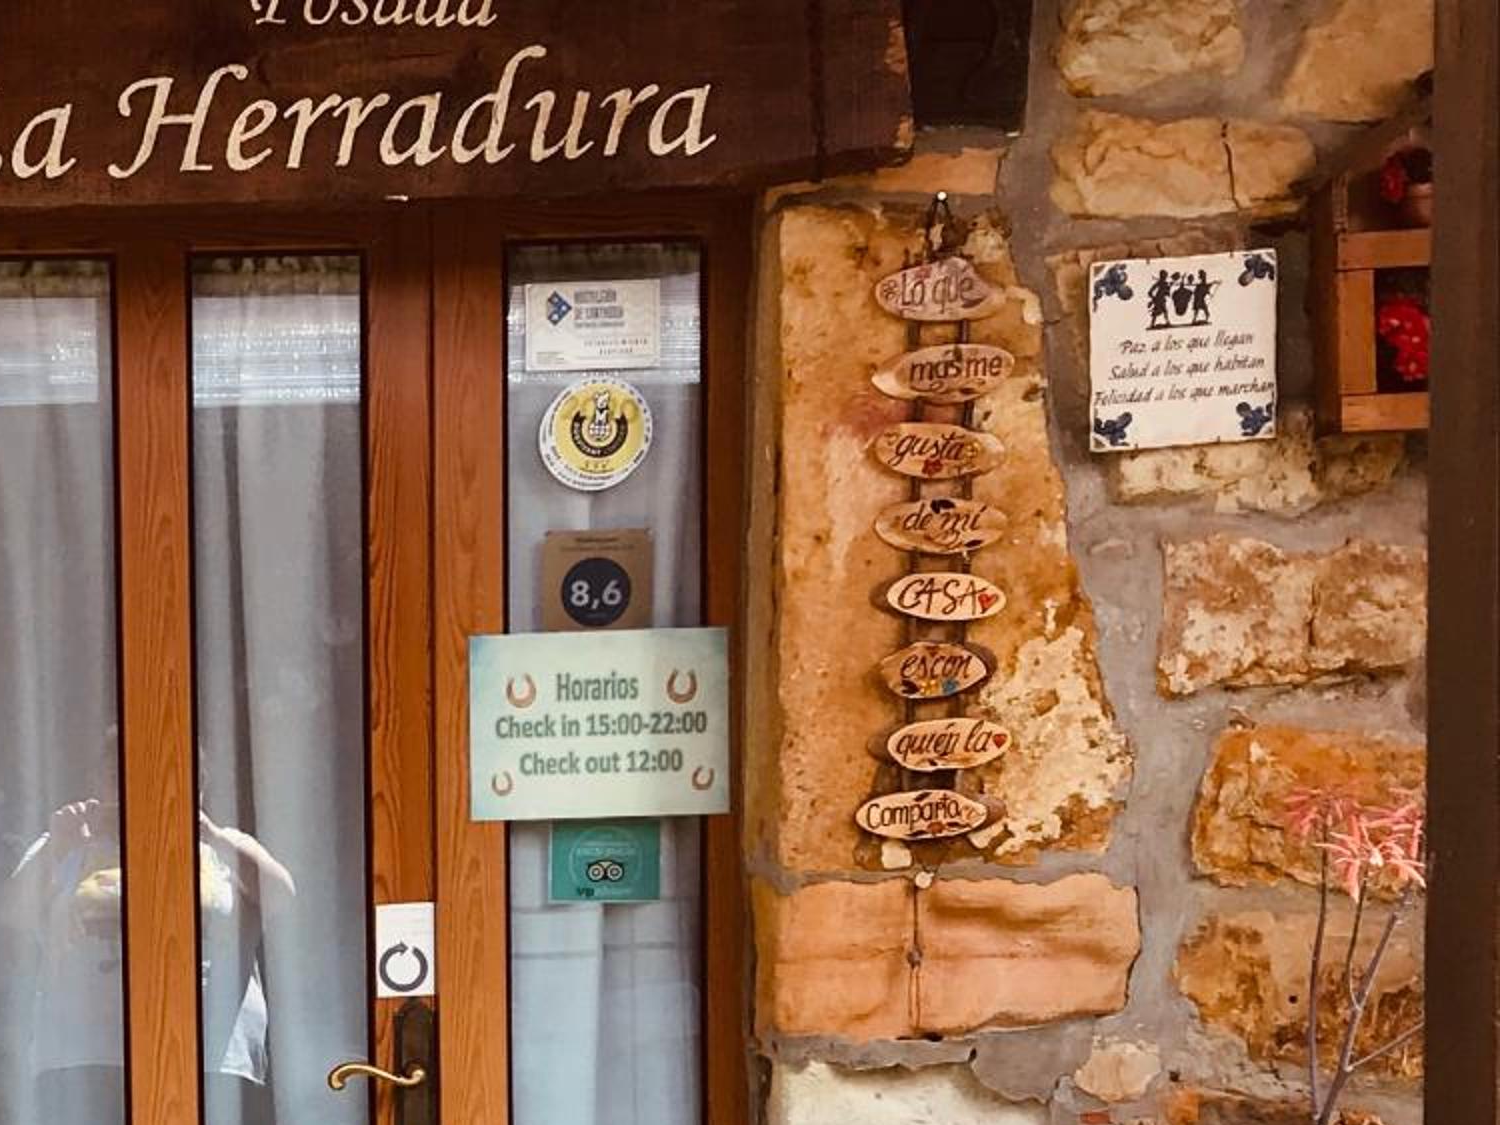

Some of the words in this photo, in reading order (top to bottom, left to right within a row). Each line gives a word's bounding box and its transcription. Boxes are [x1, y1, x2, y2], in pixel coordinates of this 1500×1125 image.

[108, 45, 717, 179] Herradura
[932, 275, 975, 314] que
[1119, 339, 1147, 355] Paz
[1151, 343, 1160, 353] a
[1164, 335, 1183, 350] los
[1187, 337, 1210, 352] que
[1214, 329, 1254, 350] llegan
[964, 355, 1003, 378] me
[1108, 362, 1148, 381] Salud
[1151, 367, 1160, 378] a
[1164, 359, 1182, 375] los
[1187, 361, 1210, 377] que
[1214, 354, 1264, 371] habitan
[1168, 384, 1186, 400] los
[1190, 386, 1214, 401] que
[1218, 377, 1275, 397] marchan
[903, 503, 932, 531] de
[570, 579, 622, 610] 8,6
[898, 577, 987, 615] CASA
[556, 669, 639, 701] Horarios
[495, 714, 556, 739] Check
[560, 714, 580, 736] in
[585, 711, 707, 737] 15:00-22:00
[963, 720, 992, 752] la
[519, 752, 580, 775] Check
[584, 752, 621, 772] out
[626, 748, 683, 773] 12:00
